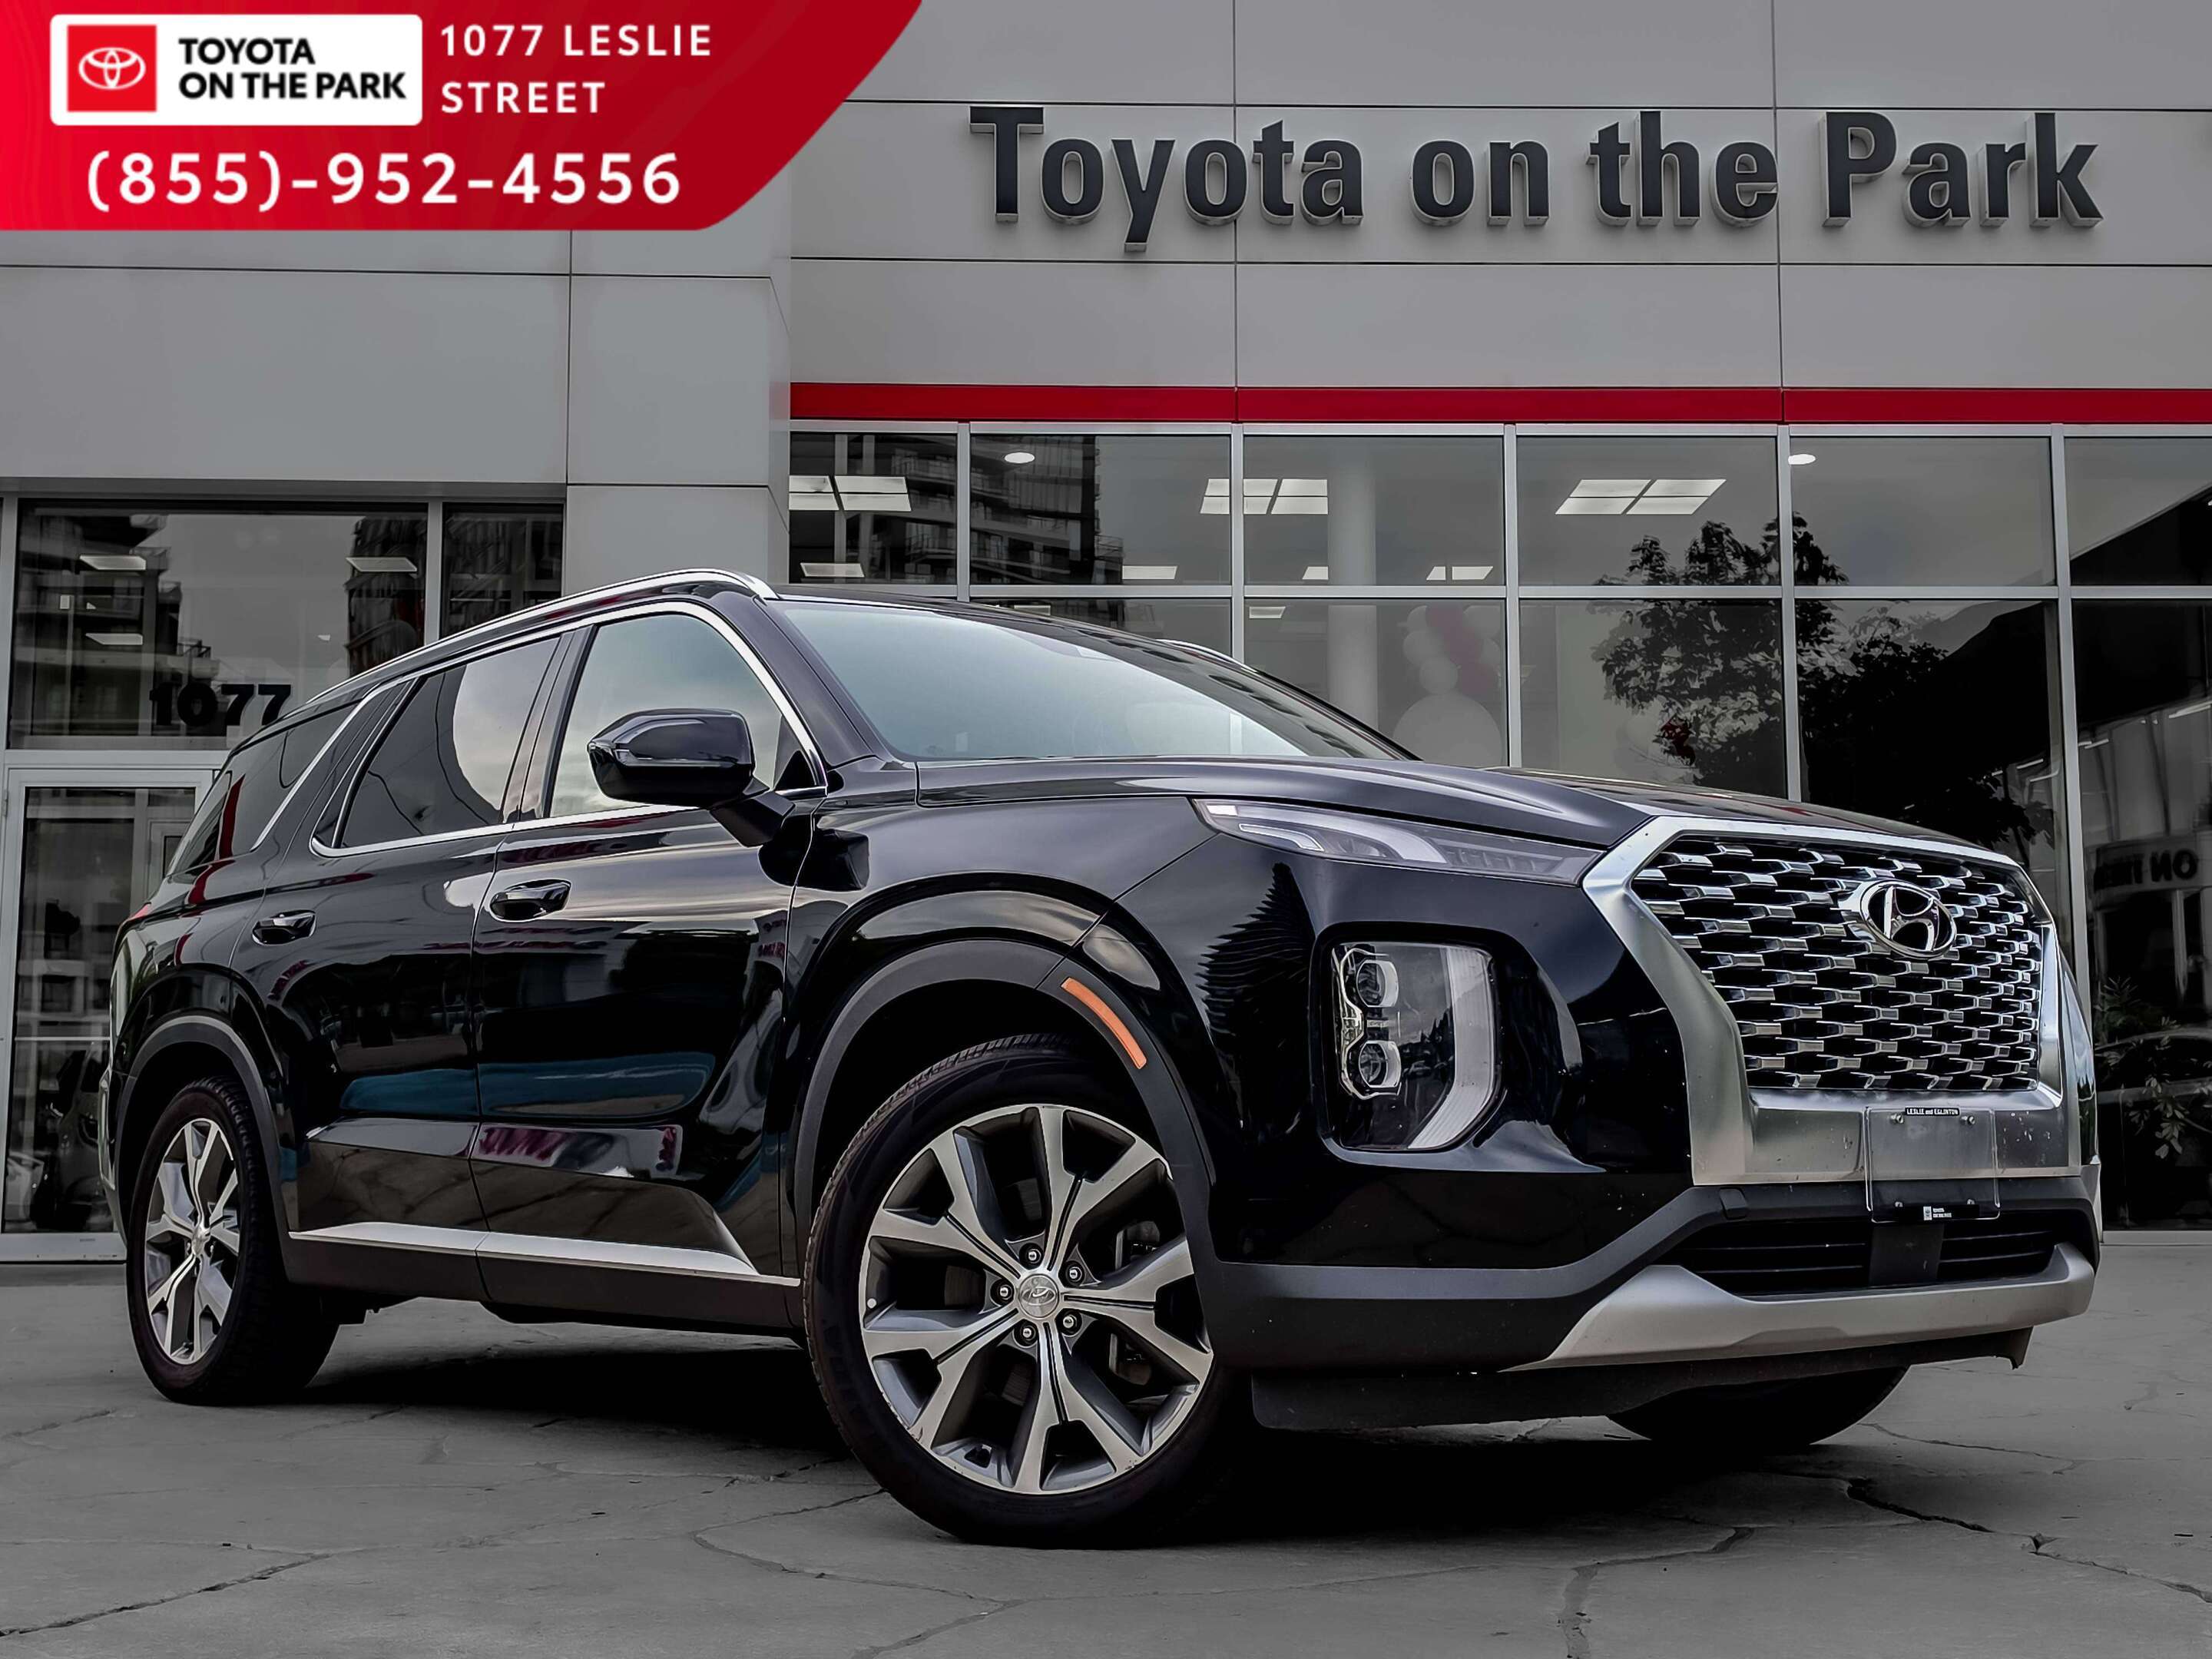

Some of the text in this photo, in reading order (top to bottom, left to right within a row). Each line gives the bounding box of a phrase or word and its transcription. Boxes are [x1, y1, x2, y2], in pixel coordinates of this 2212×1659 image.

[969, 106, 2104, 252] Toyota on the Park
[149, 682, 292, 727] 1077
